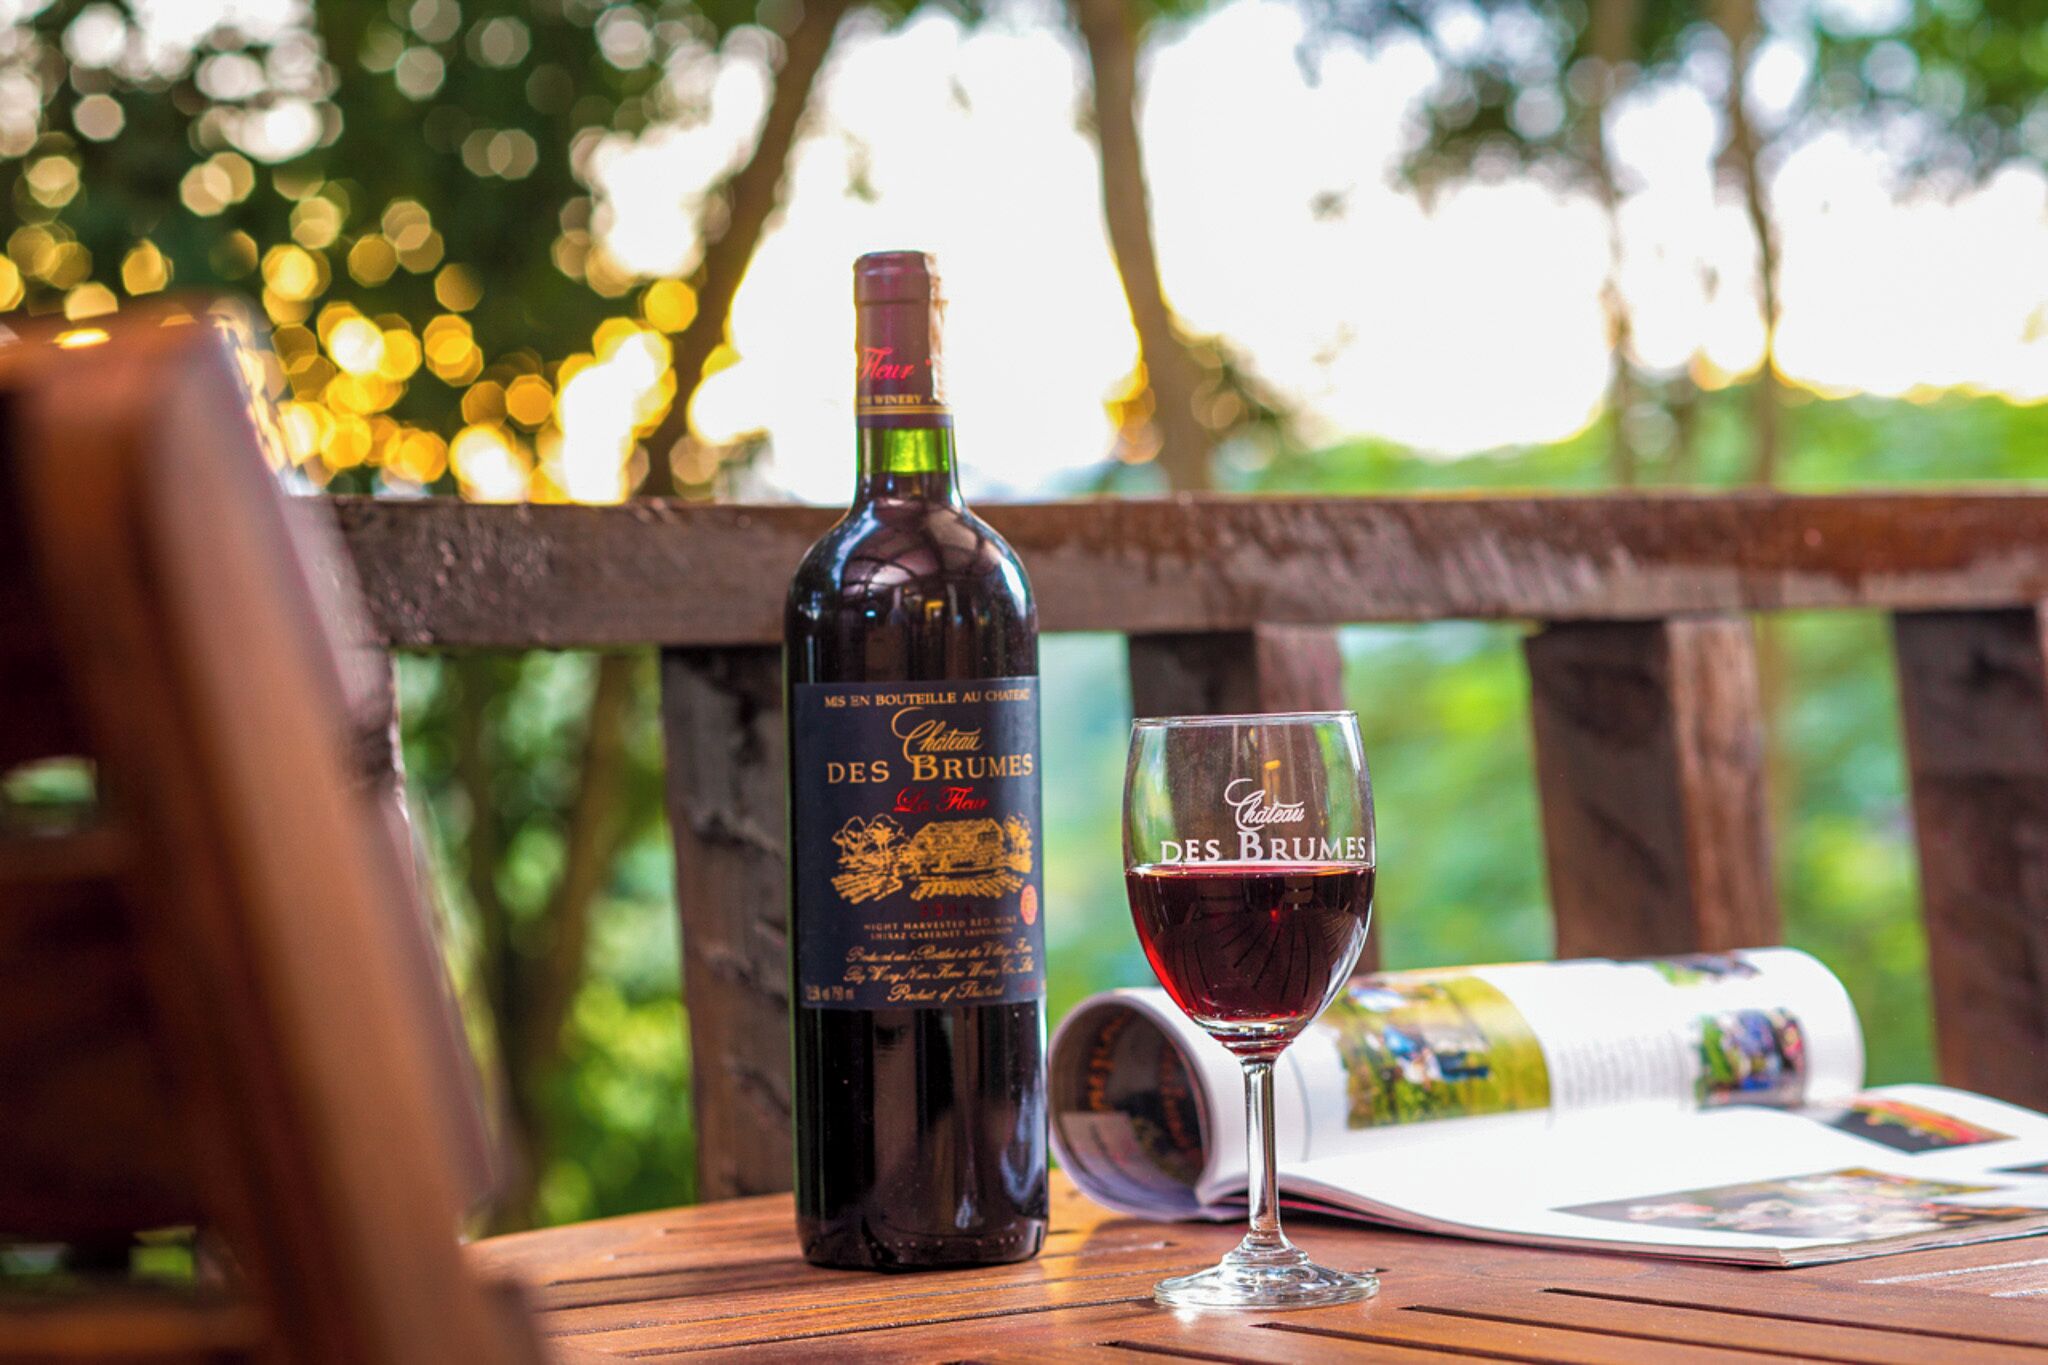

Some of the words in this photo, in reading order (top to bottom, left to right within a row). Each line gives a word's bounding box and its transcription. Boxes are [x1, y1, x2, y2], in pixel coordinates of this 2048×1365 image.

[873, 394, 922, 405] WINERY
[824, 696, 847, 708] MIS
[850, 695, 870, 707] EN
[875, 692, 957, 706] BOUTEILLE
[963, 691, 981, 703] AU
[827, 761, 890, 784] DES
[912, 753, 1034, 781] BRUMES
[1160, 838, 1220, 863] DES
[1237, 831, 1366, 862] BRUMES
[903, 920, 966, 930] HARVESTED
[910, 930, 961, 939] CABERNET
